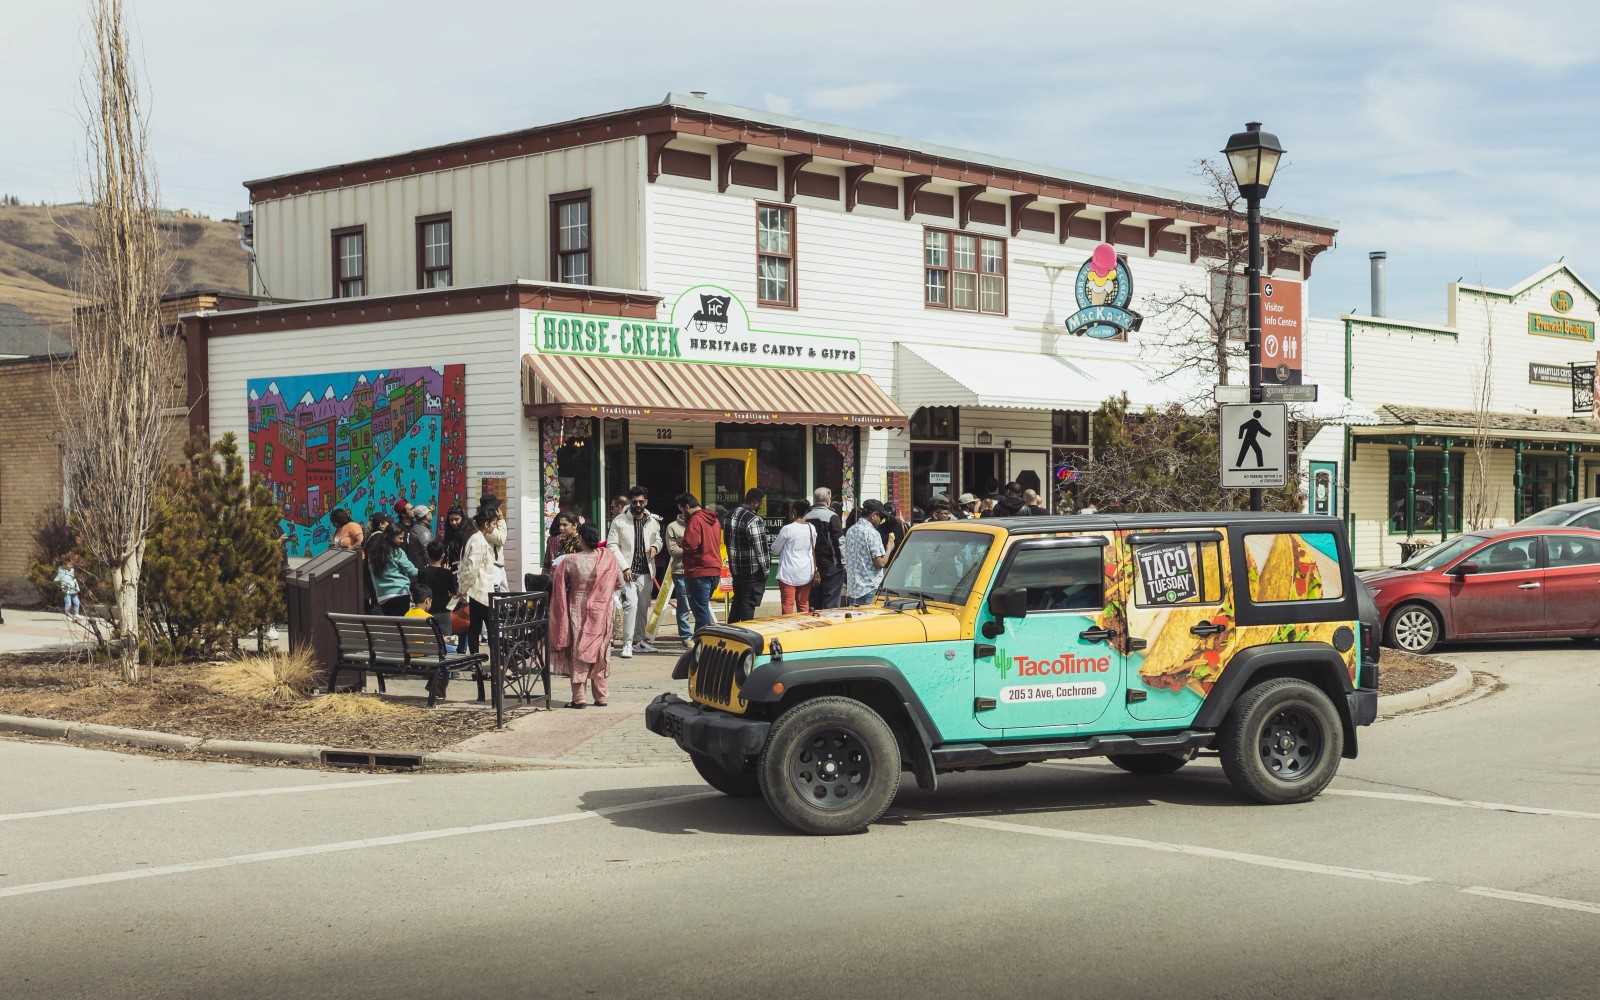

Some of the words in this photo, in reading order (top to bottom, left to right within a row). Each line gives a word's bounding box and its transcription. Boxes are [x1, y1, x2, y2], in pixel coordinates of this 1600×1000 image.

[709, 304, 723, 316] HC
[1264, 302, 1284, 312] Visitor
[1264, 316, 1276, 325] Info
[1278, 317, 1297, 327] Centre
[543, 317, 681, 357] HORSE-CREEK
[690, 338, 757, 353] HERITAGE
[762, 343, 803, 356] CANDY
[808, 347, 816, 357] &
[821, 348, 856, 360] GIFTS
[601, 406, 641, 415] Traditions
[734, 412, 770, 420] Traditions
[656, 428, 672, 439] 222
[1141, 550, 1187, 581] TACO
[1009, 689, 1025, 700] 205
[1028, 688, 1033, 699] 3
[1035, 688, 1054, 699] Ave,
[1056, 686, 1097, 697] Cochrane
